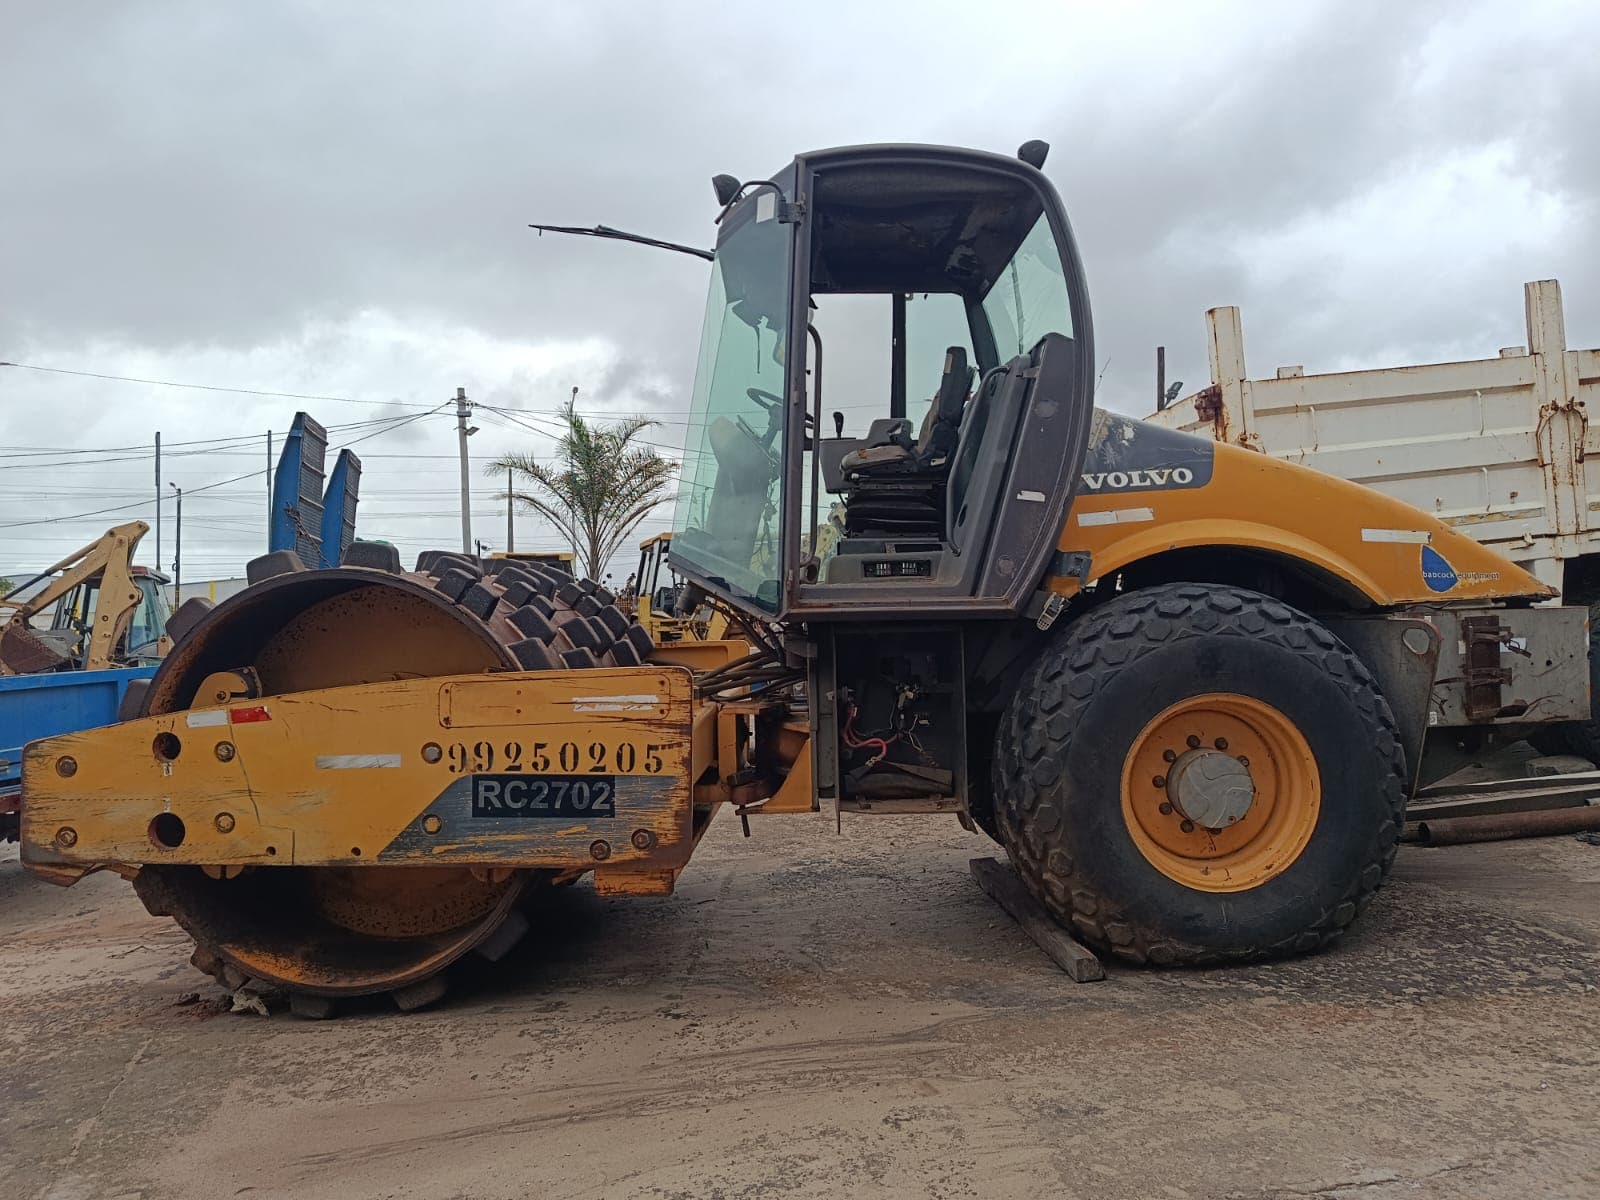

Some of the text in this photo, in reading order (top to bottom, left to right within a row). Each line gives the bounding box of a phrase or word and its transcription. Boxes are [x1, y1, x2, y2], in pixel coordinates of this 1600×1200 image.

[1080, 467, 1194, 490] VOLVO
[448, 741, 664, 773] 99250205
[477, 780, 611, 810] RC2702
